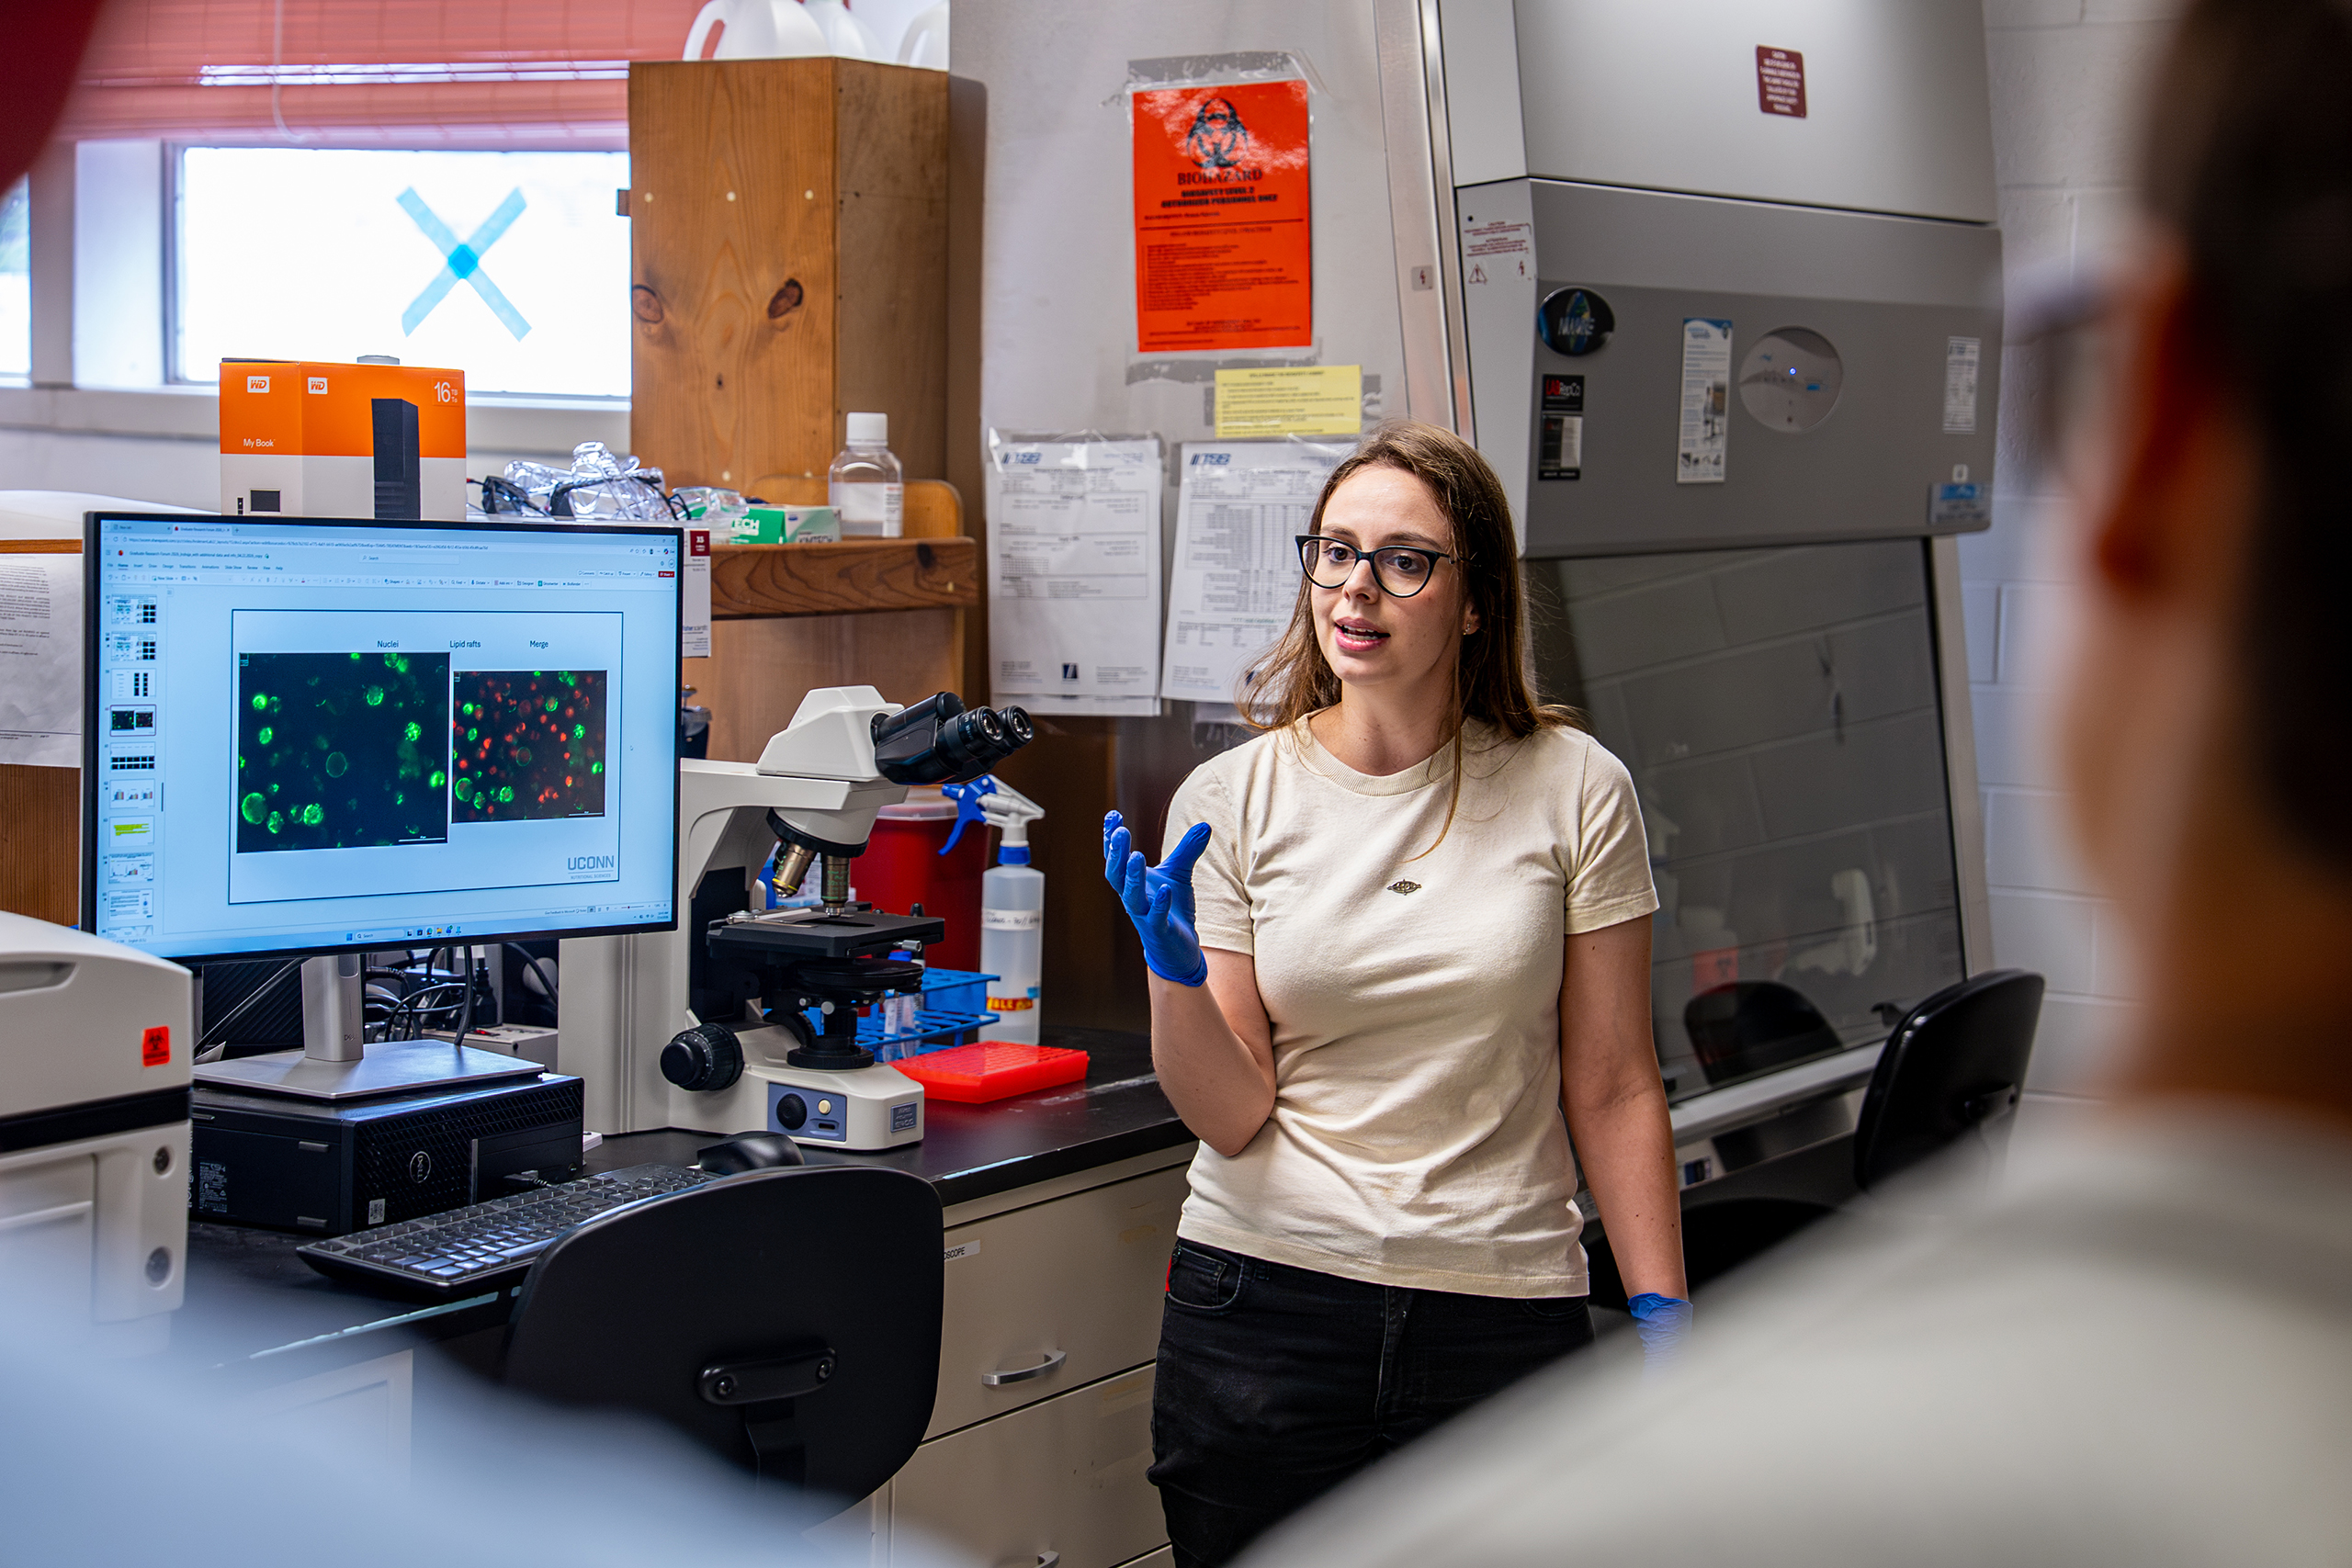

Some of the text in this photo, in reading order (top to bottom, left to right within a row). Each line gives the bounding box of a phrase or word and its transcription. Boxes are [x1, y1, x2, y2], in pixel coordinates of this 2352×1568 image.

[1177, 168, 1262, 186] BIOHAZARD
[250, 379, 267, 389] WD
[311, 380, 325, 391] WD
[434, 381, 451, 403] 16
[243, 438, 275, 448] My Book
[377, 639, 400, 649] Nuclei
[449, 640, 481, 649] Lipid rafts
[529, 640, 549, 649] Merge
[567, 855, 615, 871] UCONN
